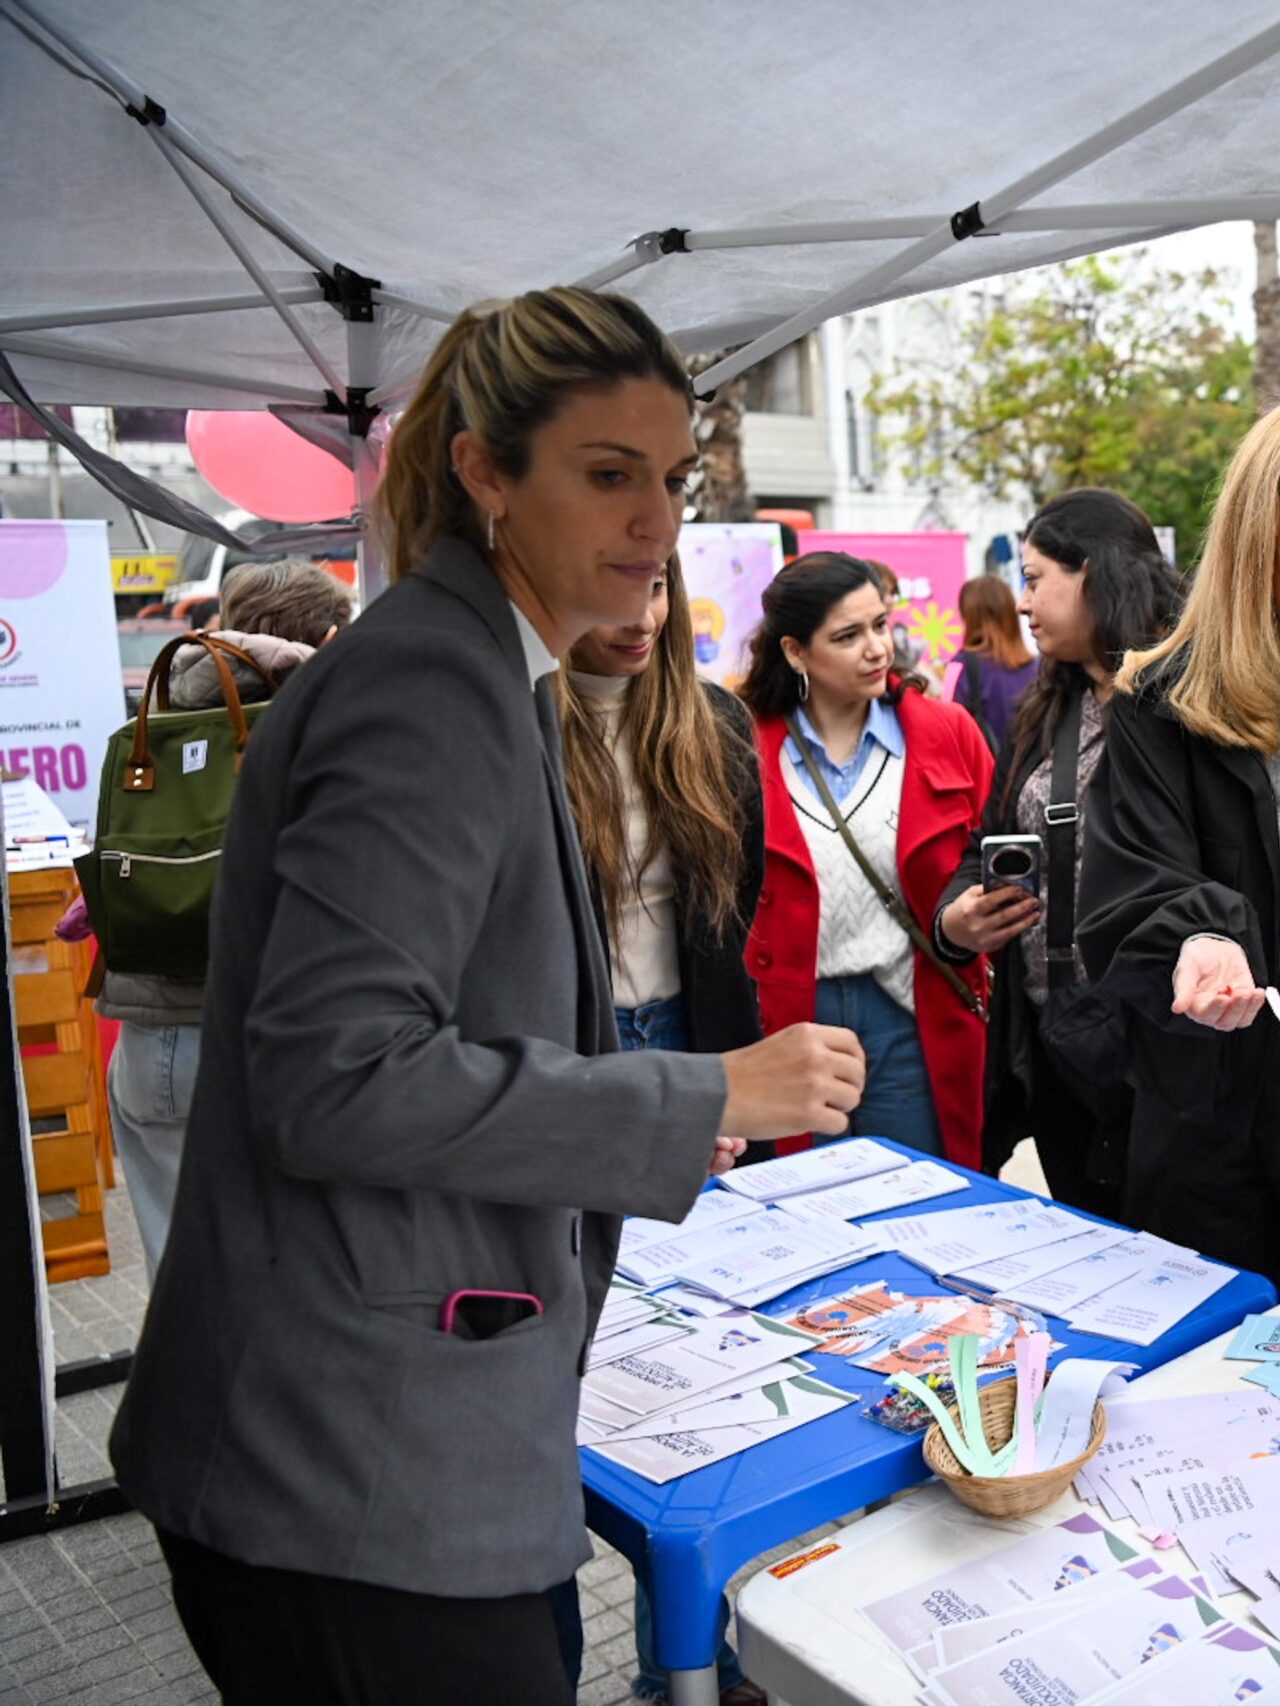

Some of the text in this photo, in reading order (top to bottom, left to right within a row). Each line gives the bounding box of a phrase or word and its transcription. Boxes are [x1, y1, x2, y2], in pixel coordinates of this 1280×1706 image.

[0, 720, 63, 734] ROVINCIAL
[995, 1665, 1045, 1706] ORTANCIA
[1005, 1655, 1063, 1706] TOCUIDADO
